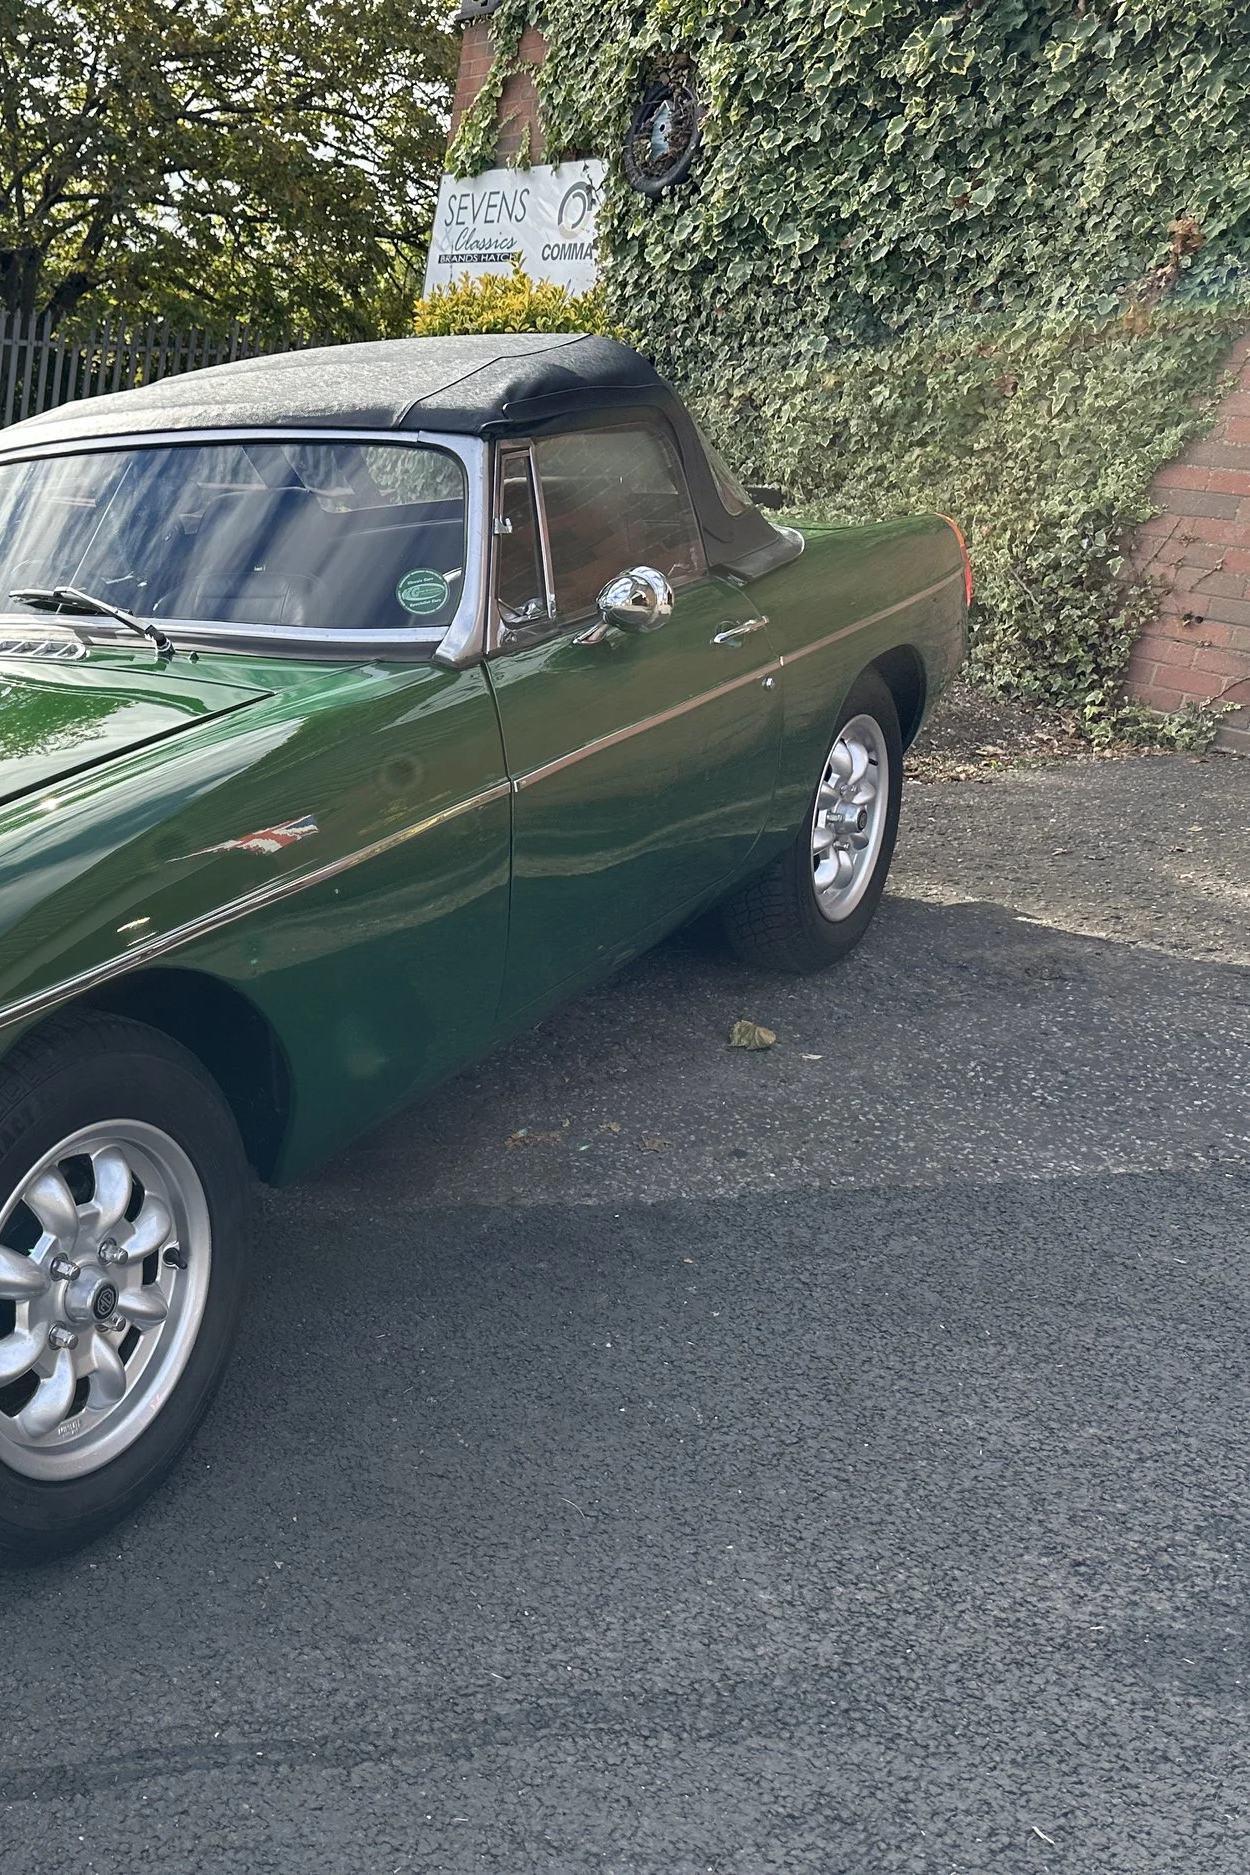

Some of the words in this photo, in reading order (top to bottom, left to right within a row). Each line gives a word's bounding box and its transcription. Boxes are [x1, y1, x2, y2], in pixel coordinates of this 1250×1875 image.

[444, 188, 530, 227] SEVENS
[453, 226, 518, 252] Classics
[439, 252, 479, 264] BRANDS
[541, 242, 593, 262] COMMA
